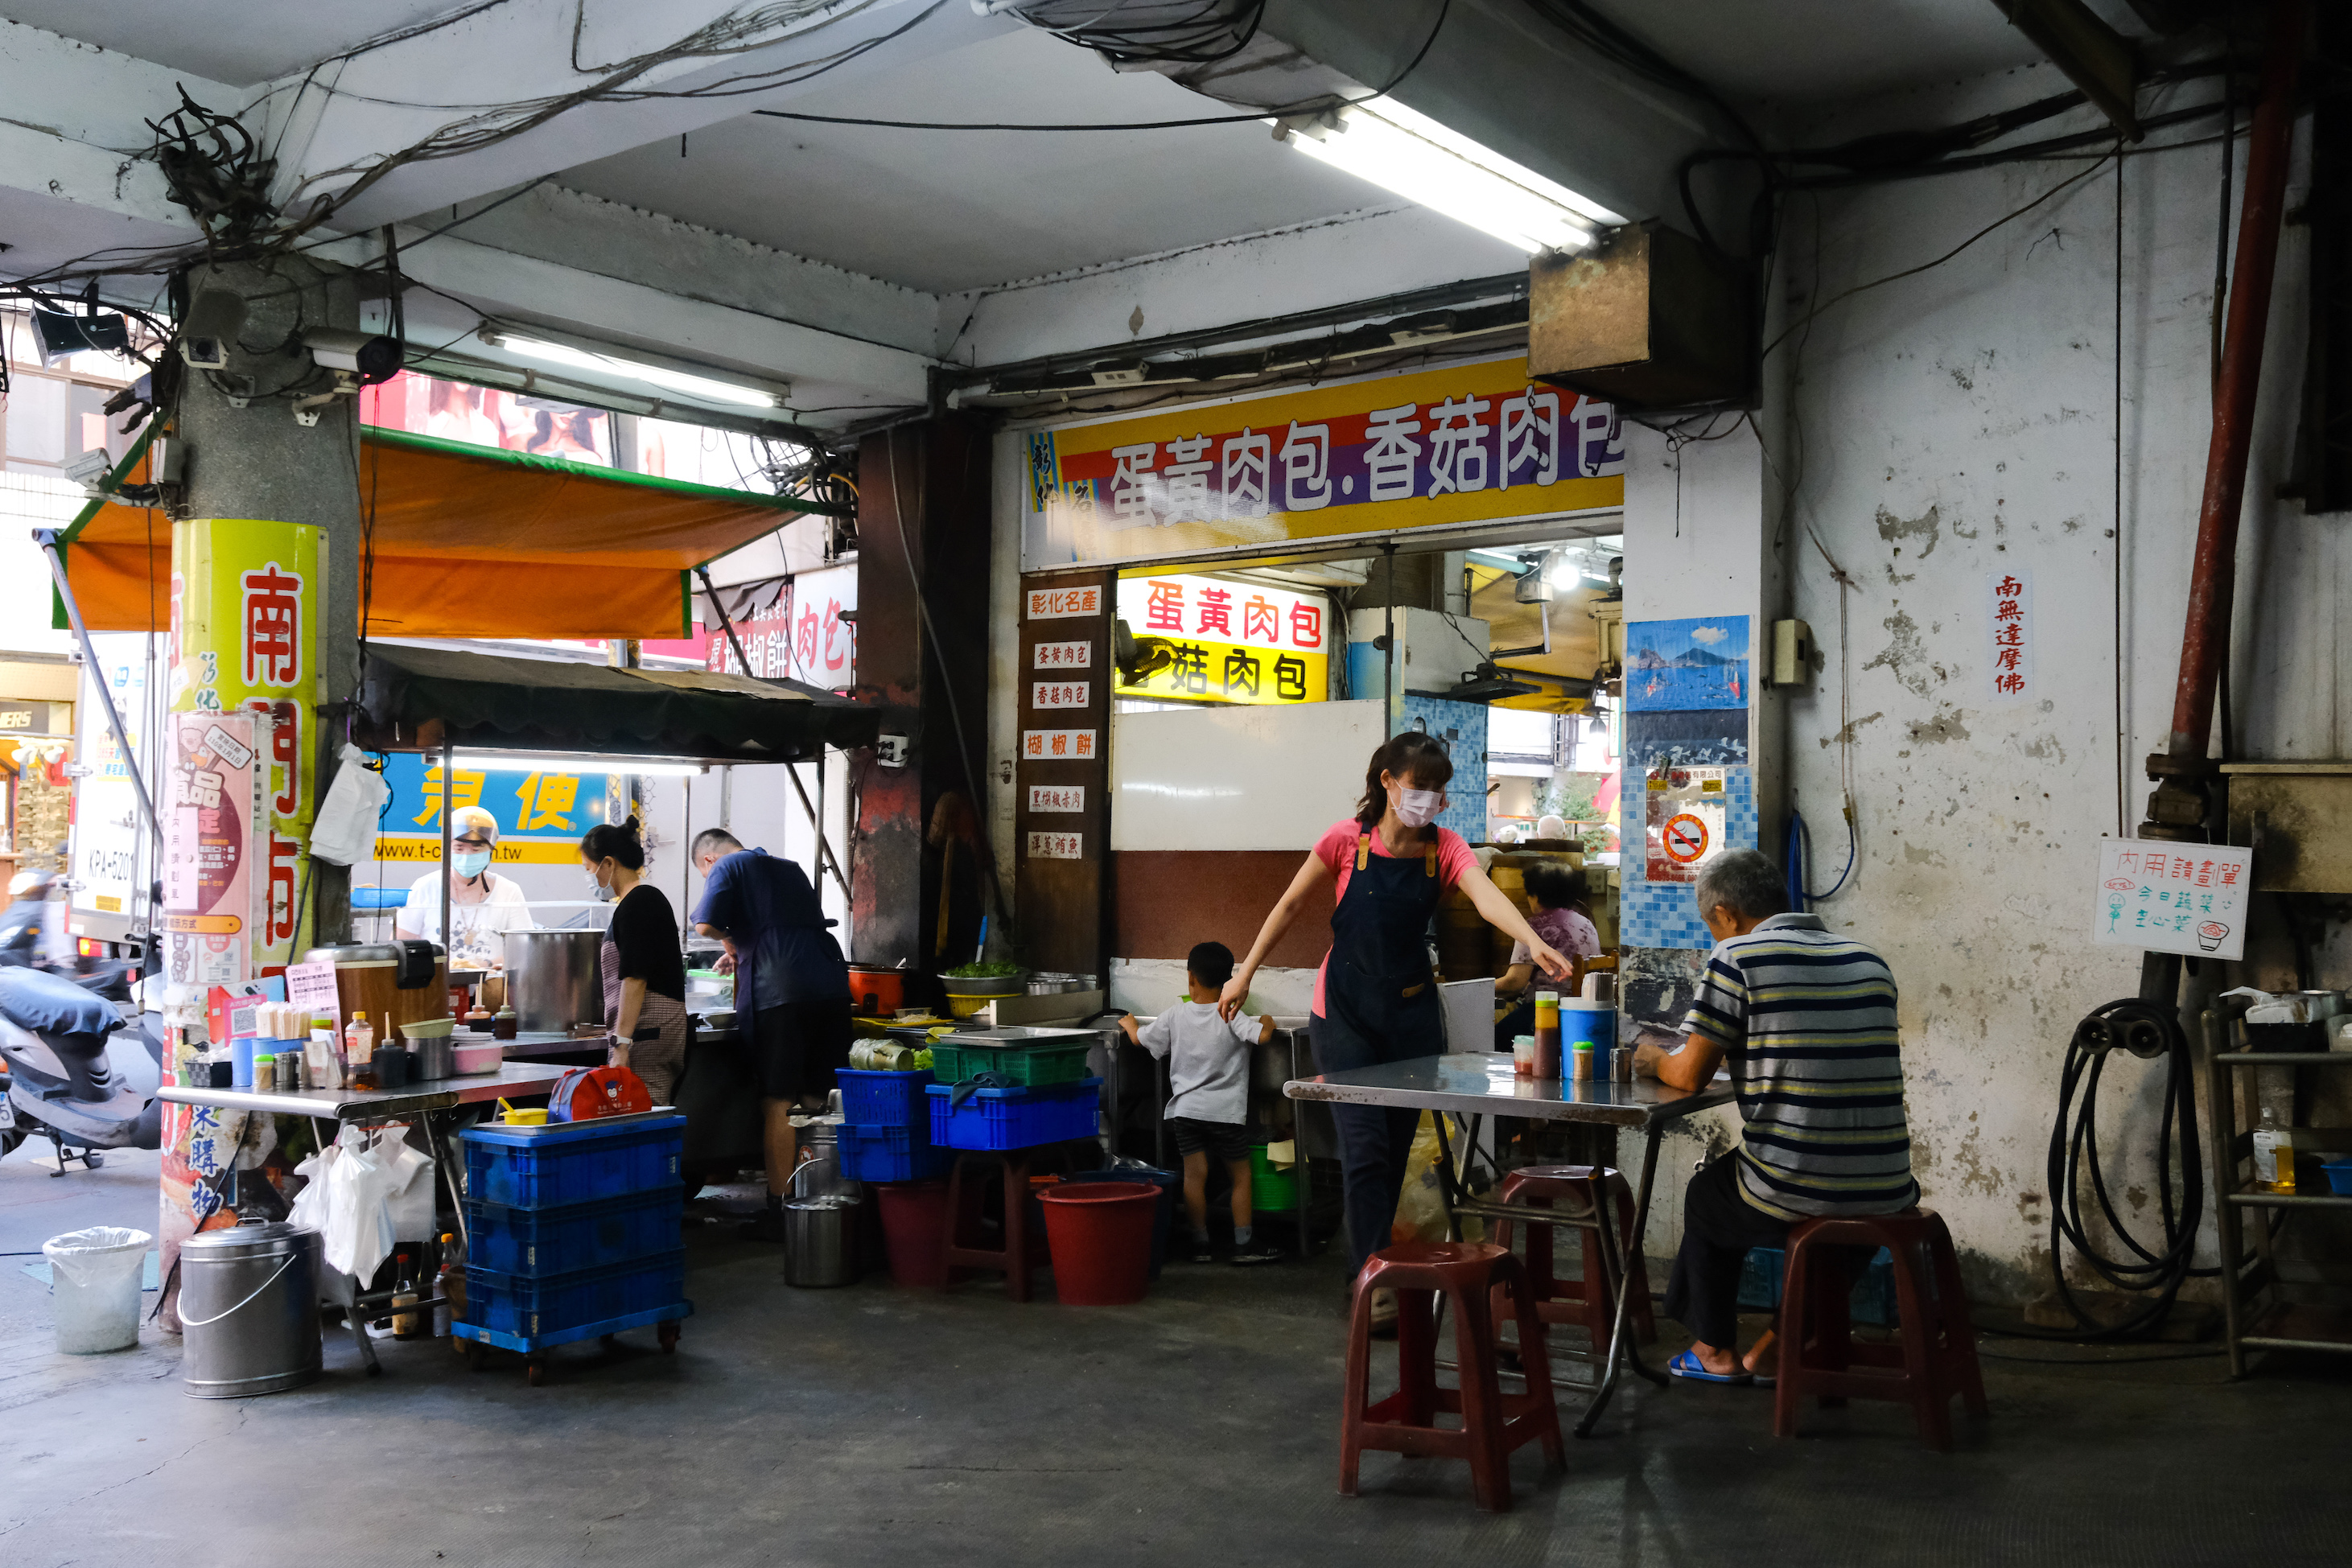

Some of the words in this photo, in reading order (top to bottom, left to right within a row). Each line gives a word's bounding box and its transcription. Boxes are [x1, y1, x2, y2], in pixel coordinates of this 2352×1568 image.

[1031, 590, 1097, 615] 彰化名產
[1146, 579, 1321, 648] 蛋黃肉包
[1994, 575, 2025, 695] 南無達摩佛
[1135, 641, 1307, 700] 菇肉包
[1036, 685, 1085, 705] 香菇肉包
[89, 849, 134, 882] KPA-5201
[2138, 886, 2214, 914] 今日蔬菜
[2135, 908, 2193, 933] 空心菜
